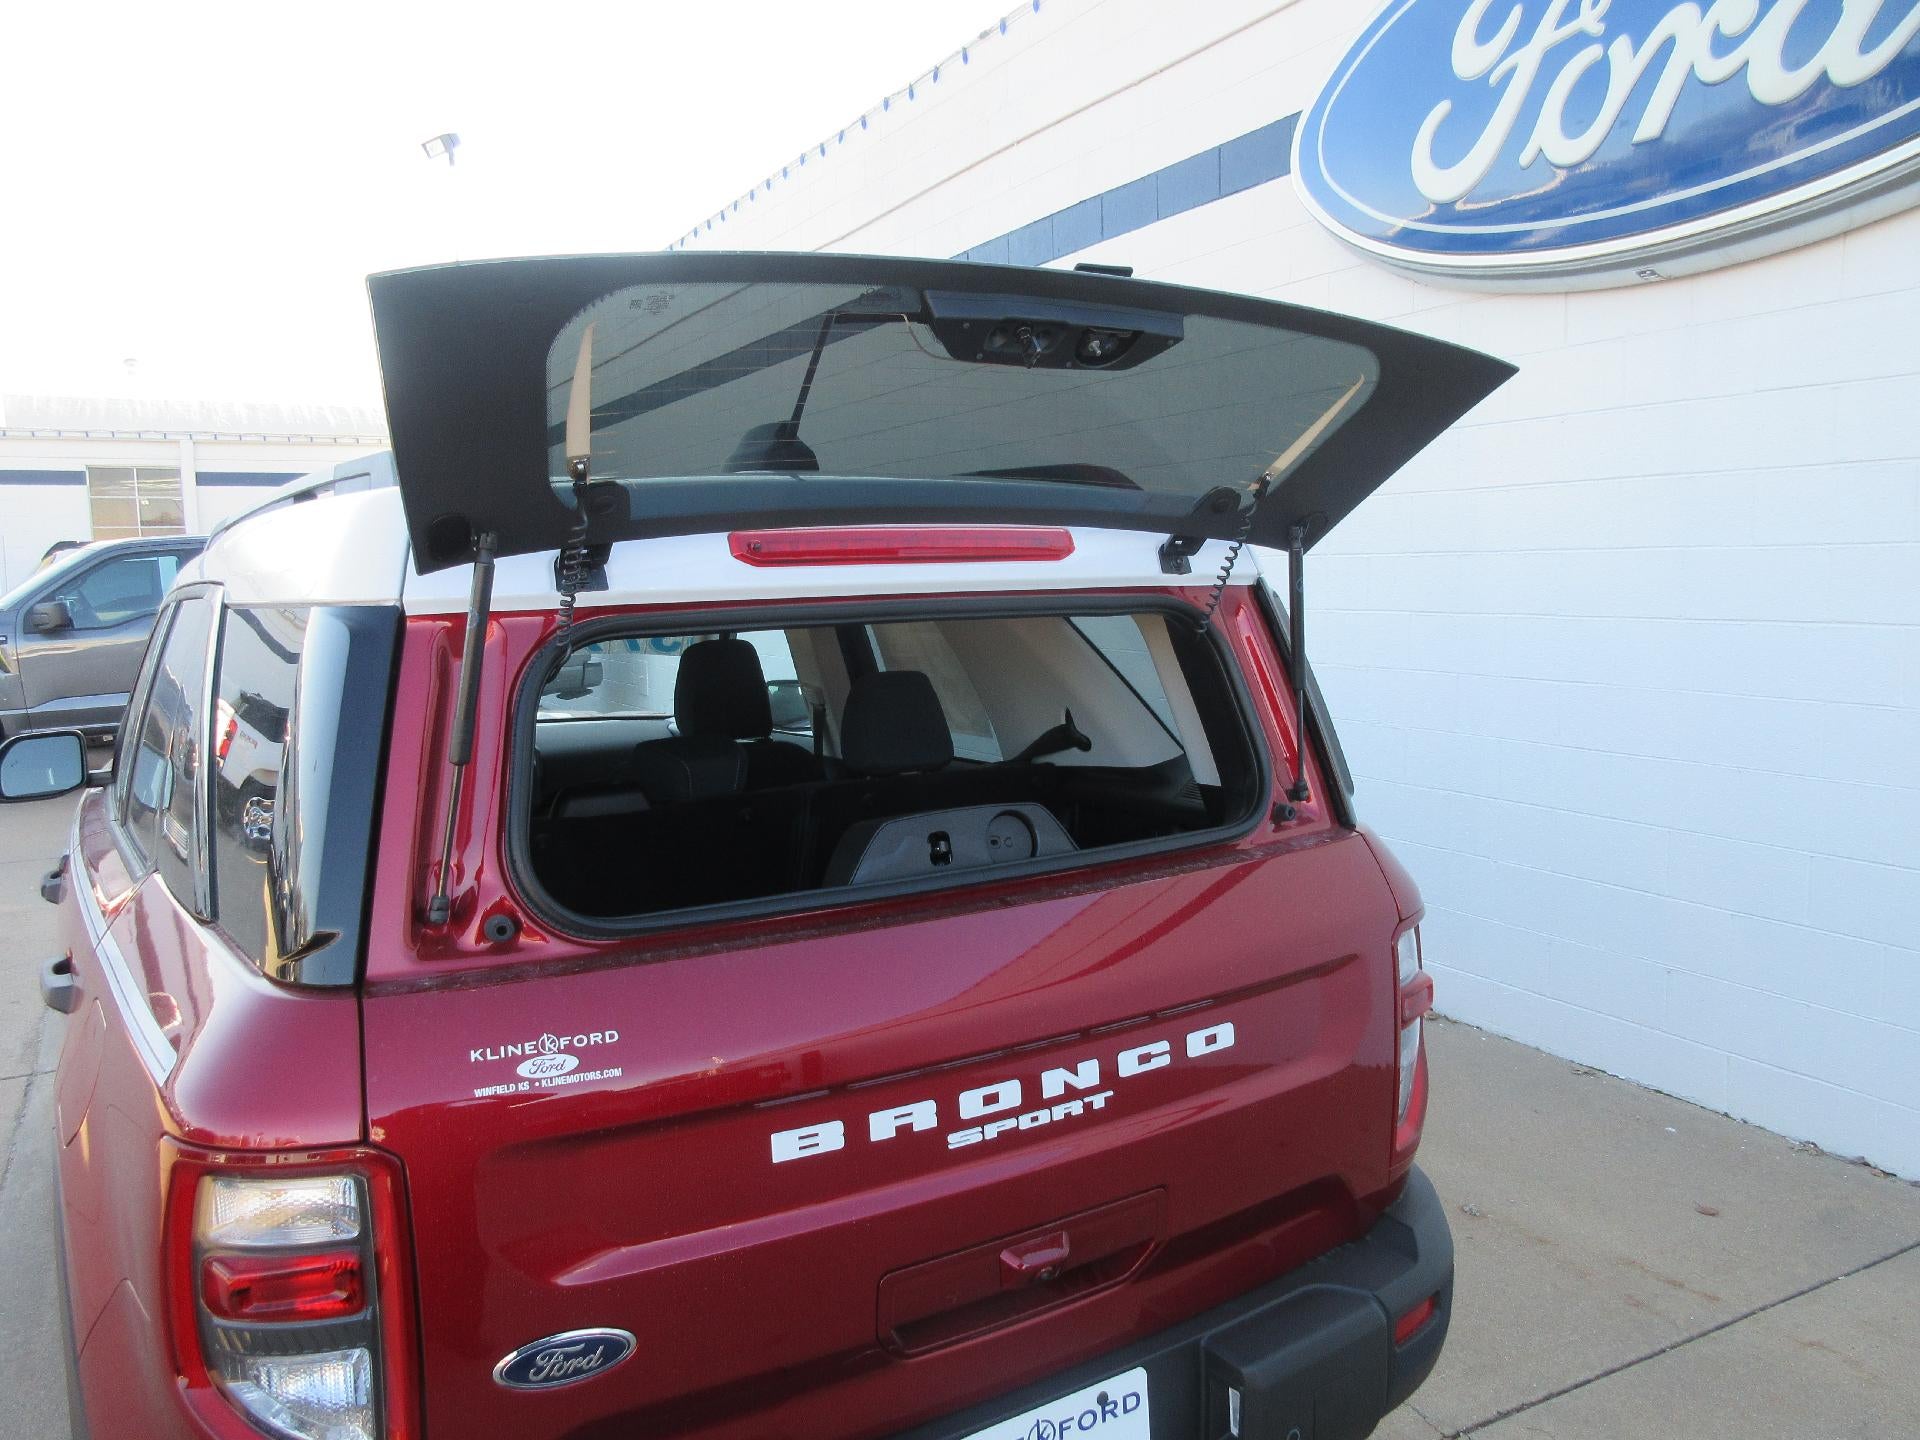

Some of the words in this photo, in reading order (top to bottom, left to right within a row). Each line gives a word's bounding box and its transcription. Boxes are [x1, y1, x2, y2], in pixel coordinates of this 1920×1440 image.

[470, 1041, 538, 1062] KLINE
[560, 1030, 619, 1050] FORD
[528, 1057, 566, 1075] Ford
[474, 1083, 516, 1098] WINFIELD
[518, 1081, 530, 1092] KS
[541, 1067, 622, 1088] KLINEMOTORS.COM
[771, 1021, 1235, 1163] BRONCO
[947, 1090, 1114, 1150] SPORT
[528, 1342, 605, 1382] Ford
[1059, 1391, 1141, 1440] FORD
